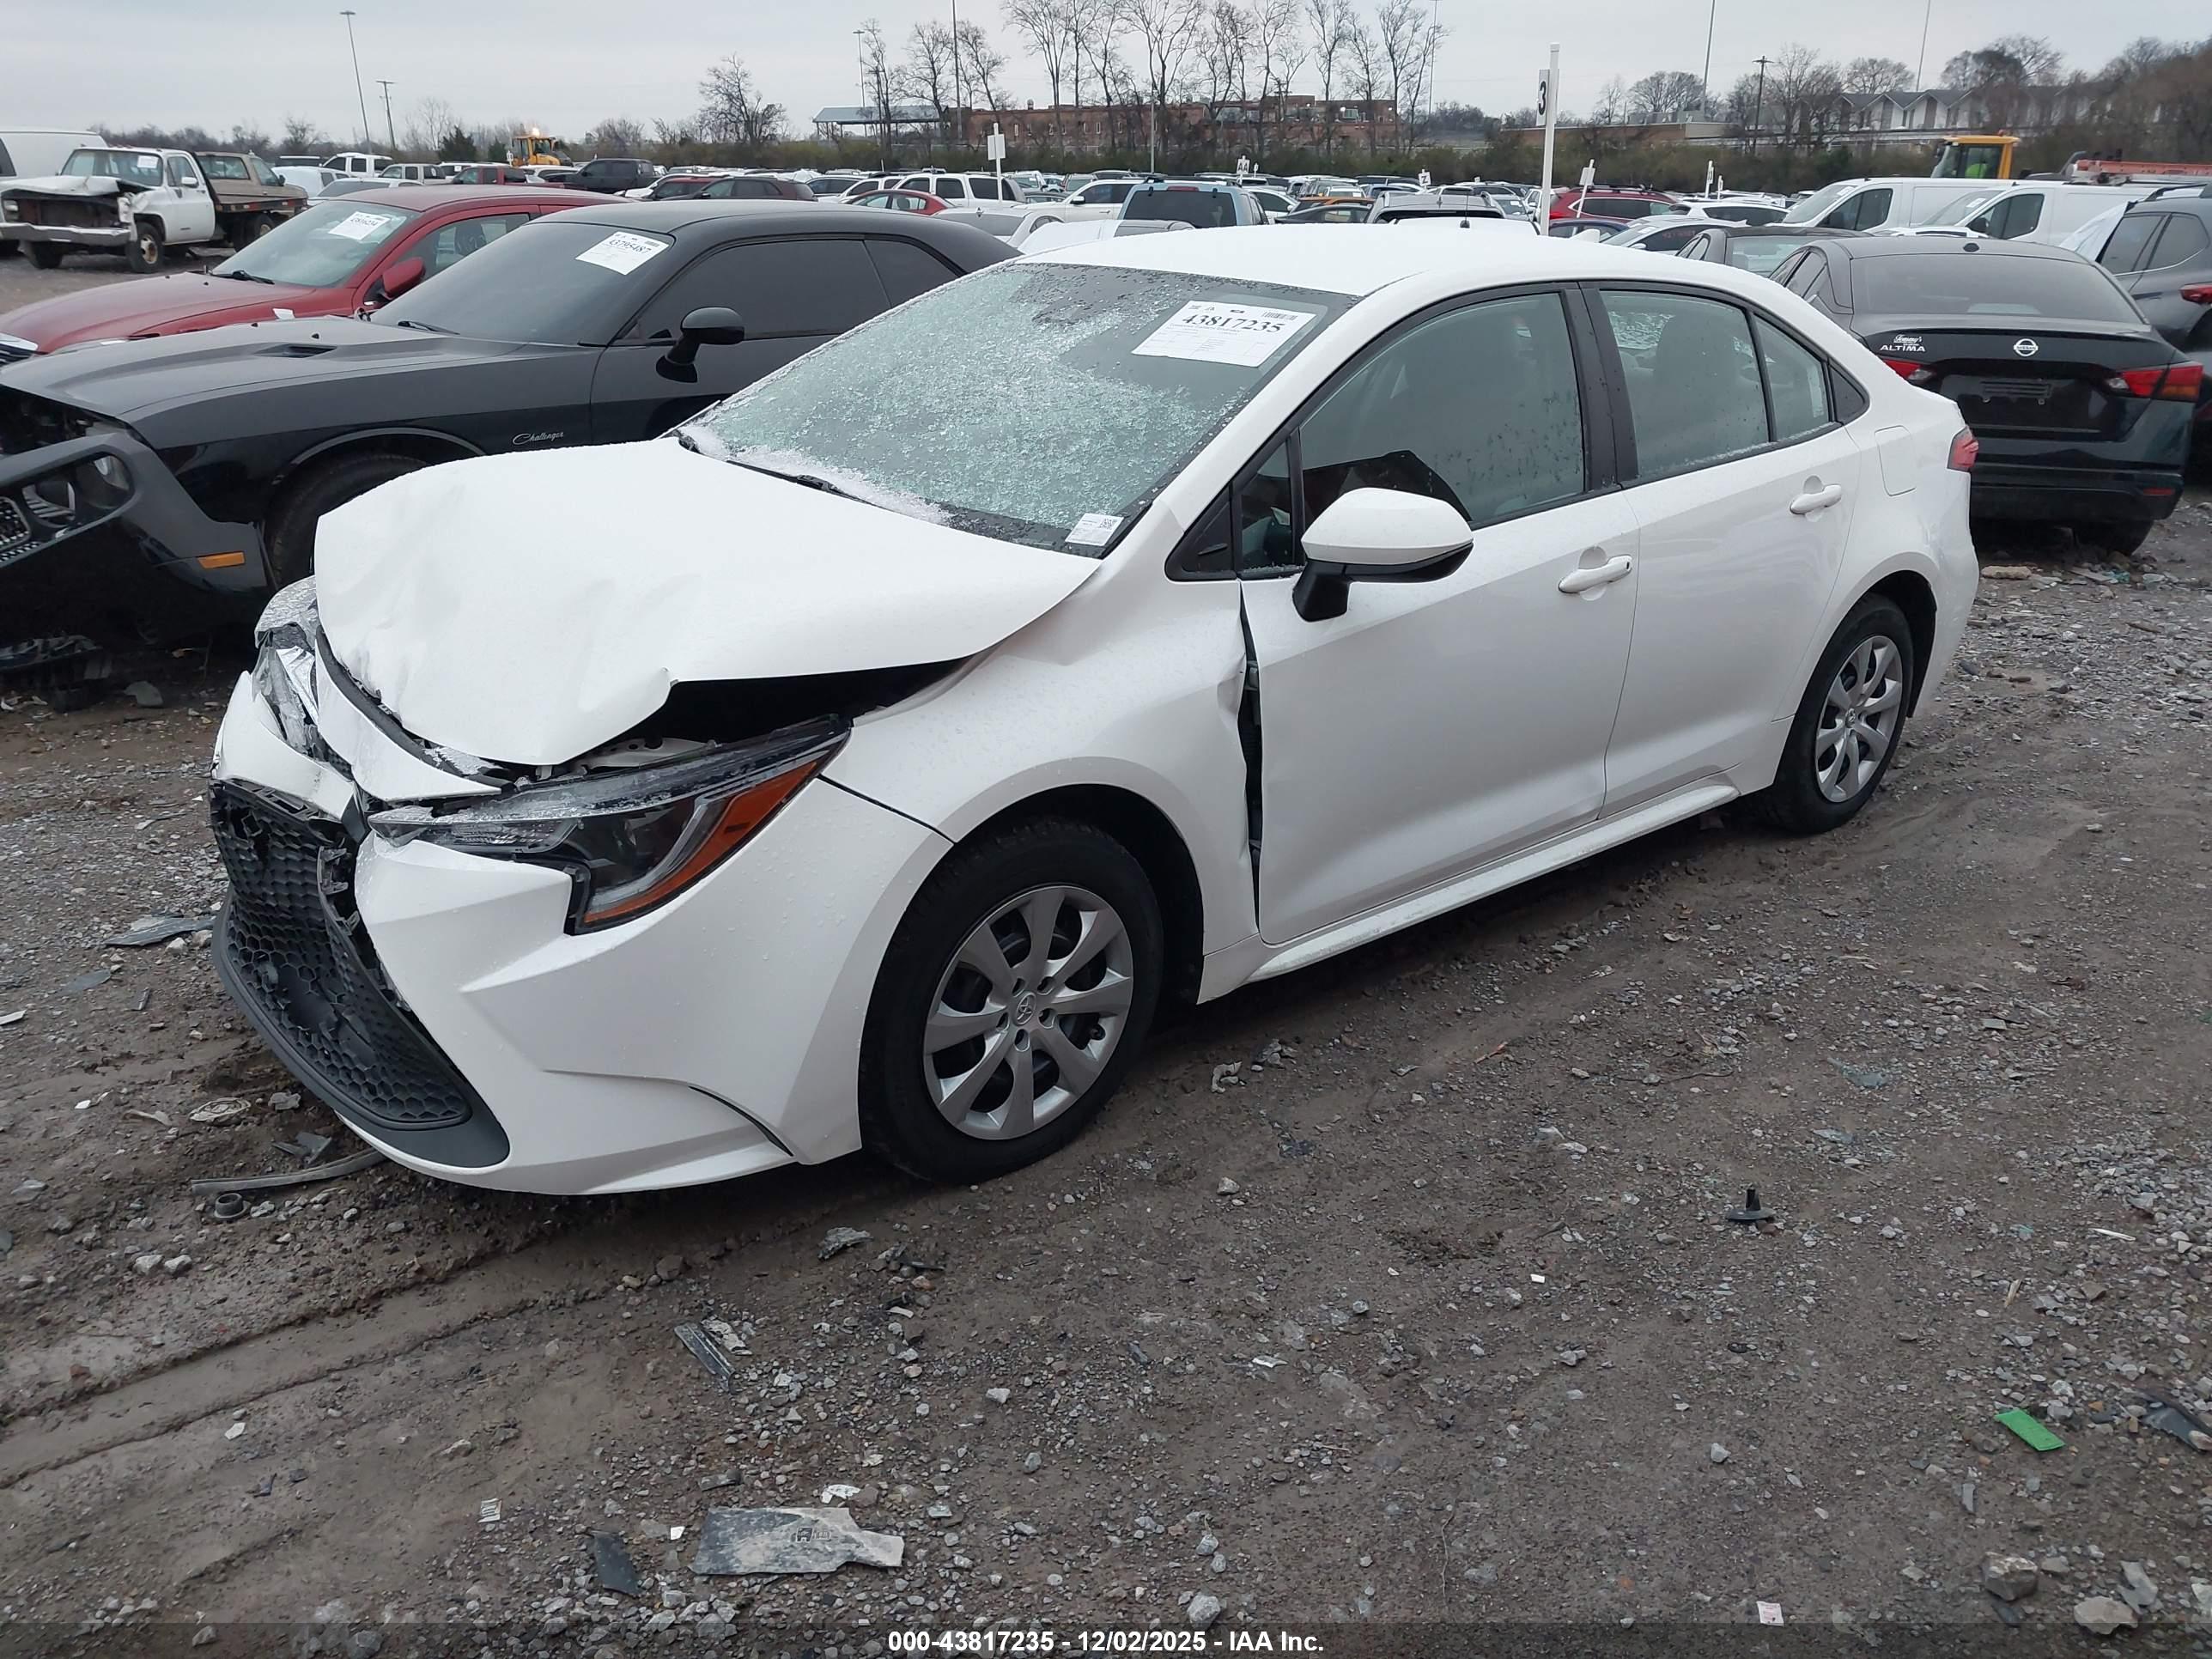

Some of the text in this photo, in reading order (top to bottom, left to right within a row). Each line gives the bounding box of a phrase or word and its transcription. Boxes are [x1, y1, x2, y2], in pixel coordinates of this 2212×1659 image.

[1538, 80, 1547, 116] 3
[1182, 314, 1285, 333] 43817235
[512, 431, 564, 446] Challenger
